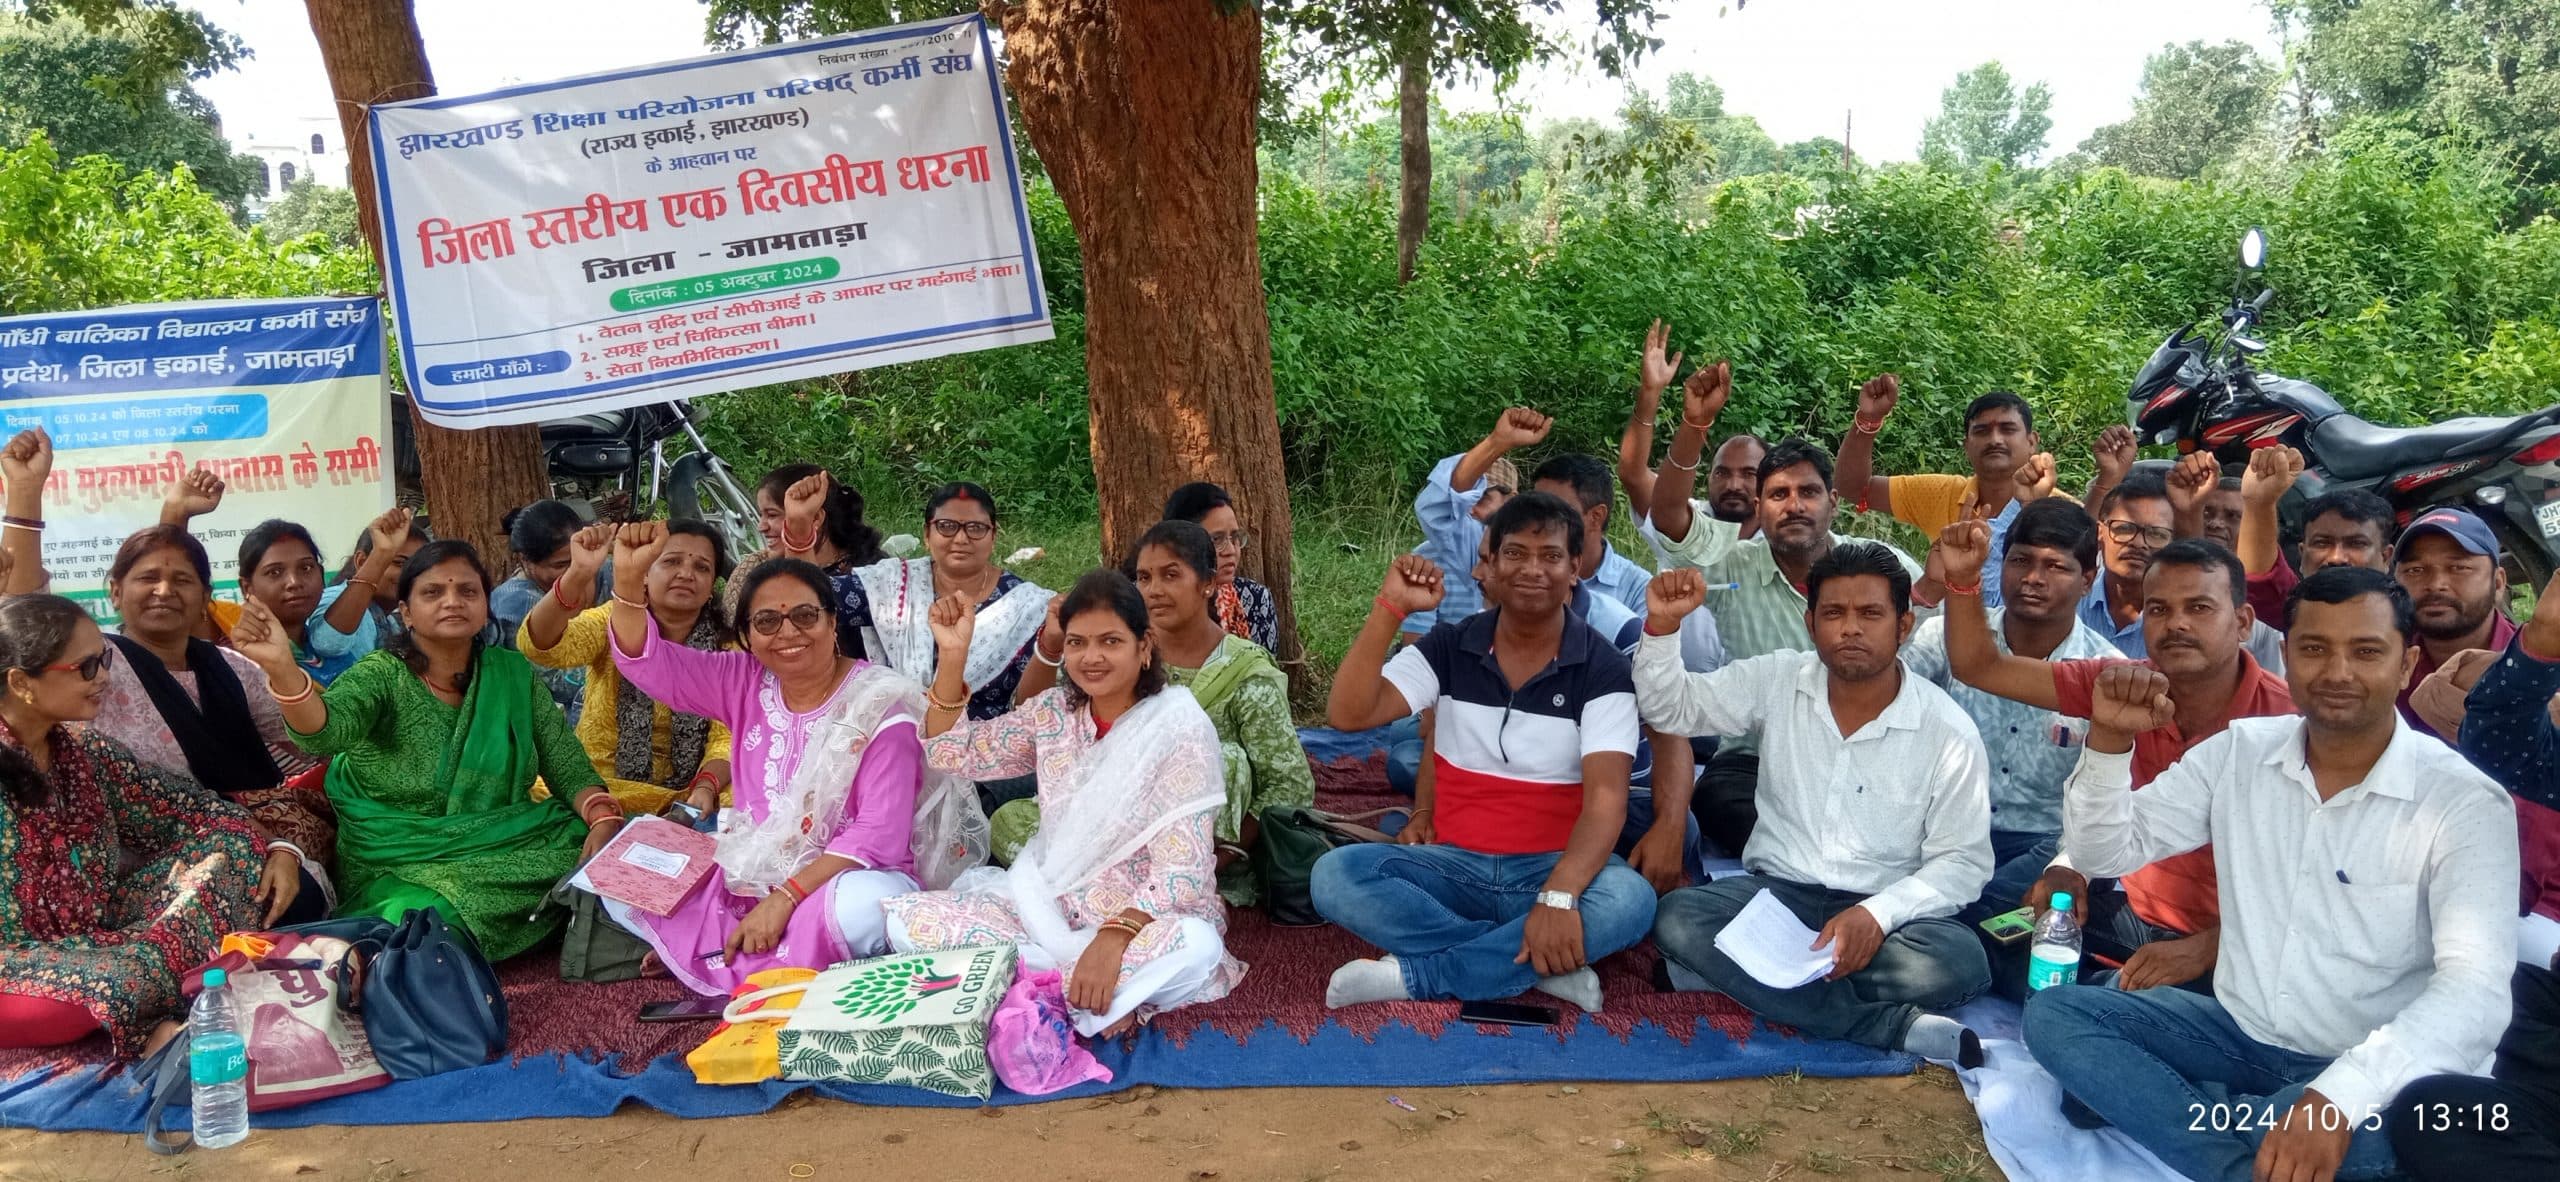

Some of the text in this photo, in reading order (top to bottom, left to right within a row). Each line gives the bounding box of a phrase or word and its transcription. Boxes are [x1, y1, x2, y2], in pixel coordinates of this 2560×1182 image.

[818, 53, 856, 66] निबंधन
[396, 49, 973, 160] झारखण्ड शिक्षा परियोजना परिषद् कर्मी संघ
[581, 131, 638, 158] (राज्य
[709, 107, 810, 140] झारखण्ड)
[645, 156, 662, 174] के
[733, 147, 758, 161] पर
[417, 146, 990, 268] जिला स्तरीय एक दिवसीय धरना
[582, 251, 676, 283] जिला
[722, 222, 869, 259] जामताड़ा
[577, 333, 593, 344] 1.
[598, 322, 643, 340] वेतन
[646, 311, 687, 335] वृद्धि
[692, 306, 718, 325] एवं
[723, 293, 801, 319] सीपीआई
[805, 288, 826, 305] के
[832, 283, 886, 302] आधार
[889, 280, 914, 294] पर
[917, 267, 978, 288] महंगाई
[628, 285, 678, 305] दिनांक
[694, 280, 715, 295] 05
[783, 263, 823, 281] 2024
[56, 323, 152, 344] बालिका
[157, 318, 256, 340] विद्यालय
[260, 307, 321, 331] कर्मी
[325, 304, 369, 328] संघ
[580, 352, 597, 363] 2.
[602, 341, 649, 361] समूह
[653, 332, 681, 350] एवं
[685, 318, 762, 345] चिकित्सा
[1, 344, 357, 389] प्रदेश, जिला इकाई, जामताड़ा
[450, 364, 495, 383] हमारी
[584, 371, 601, 382] 3.
[606, 362, 643, 378] सेवा
[325, 436, 382, 487] समी
[953, 951, 996, 1015] GO GREEN
